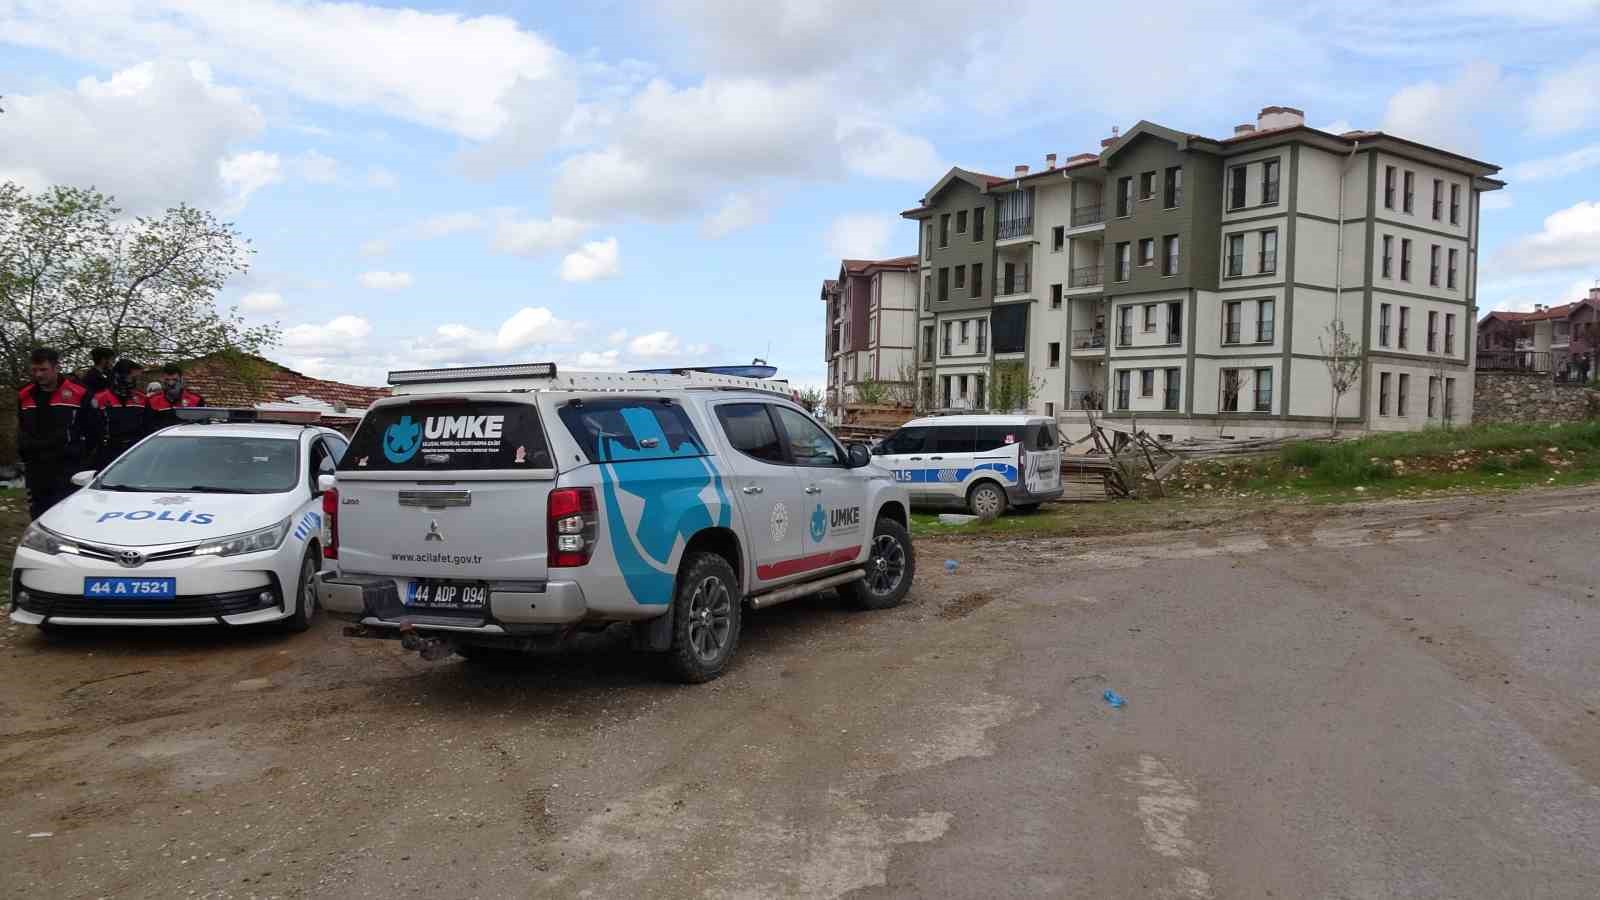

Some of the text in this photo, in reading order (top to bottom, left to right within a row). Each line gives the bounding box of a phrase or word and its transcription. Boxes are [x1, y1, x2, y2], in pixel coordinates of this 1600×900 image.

[424, 415, 504, 439] UMKE
[96, 509, 215, 524] POLİS
[831, 506, 860, 527] UMKE
[391, 552, 483, 566] www.acilafet.gov.tr
[90, 582, 168, 593] 44 A 7521
[415, 585, 484, 603] 44 ADP 094
